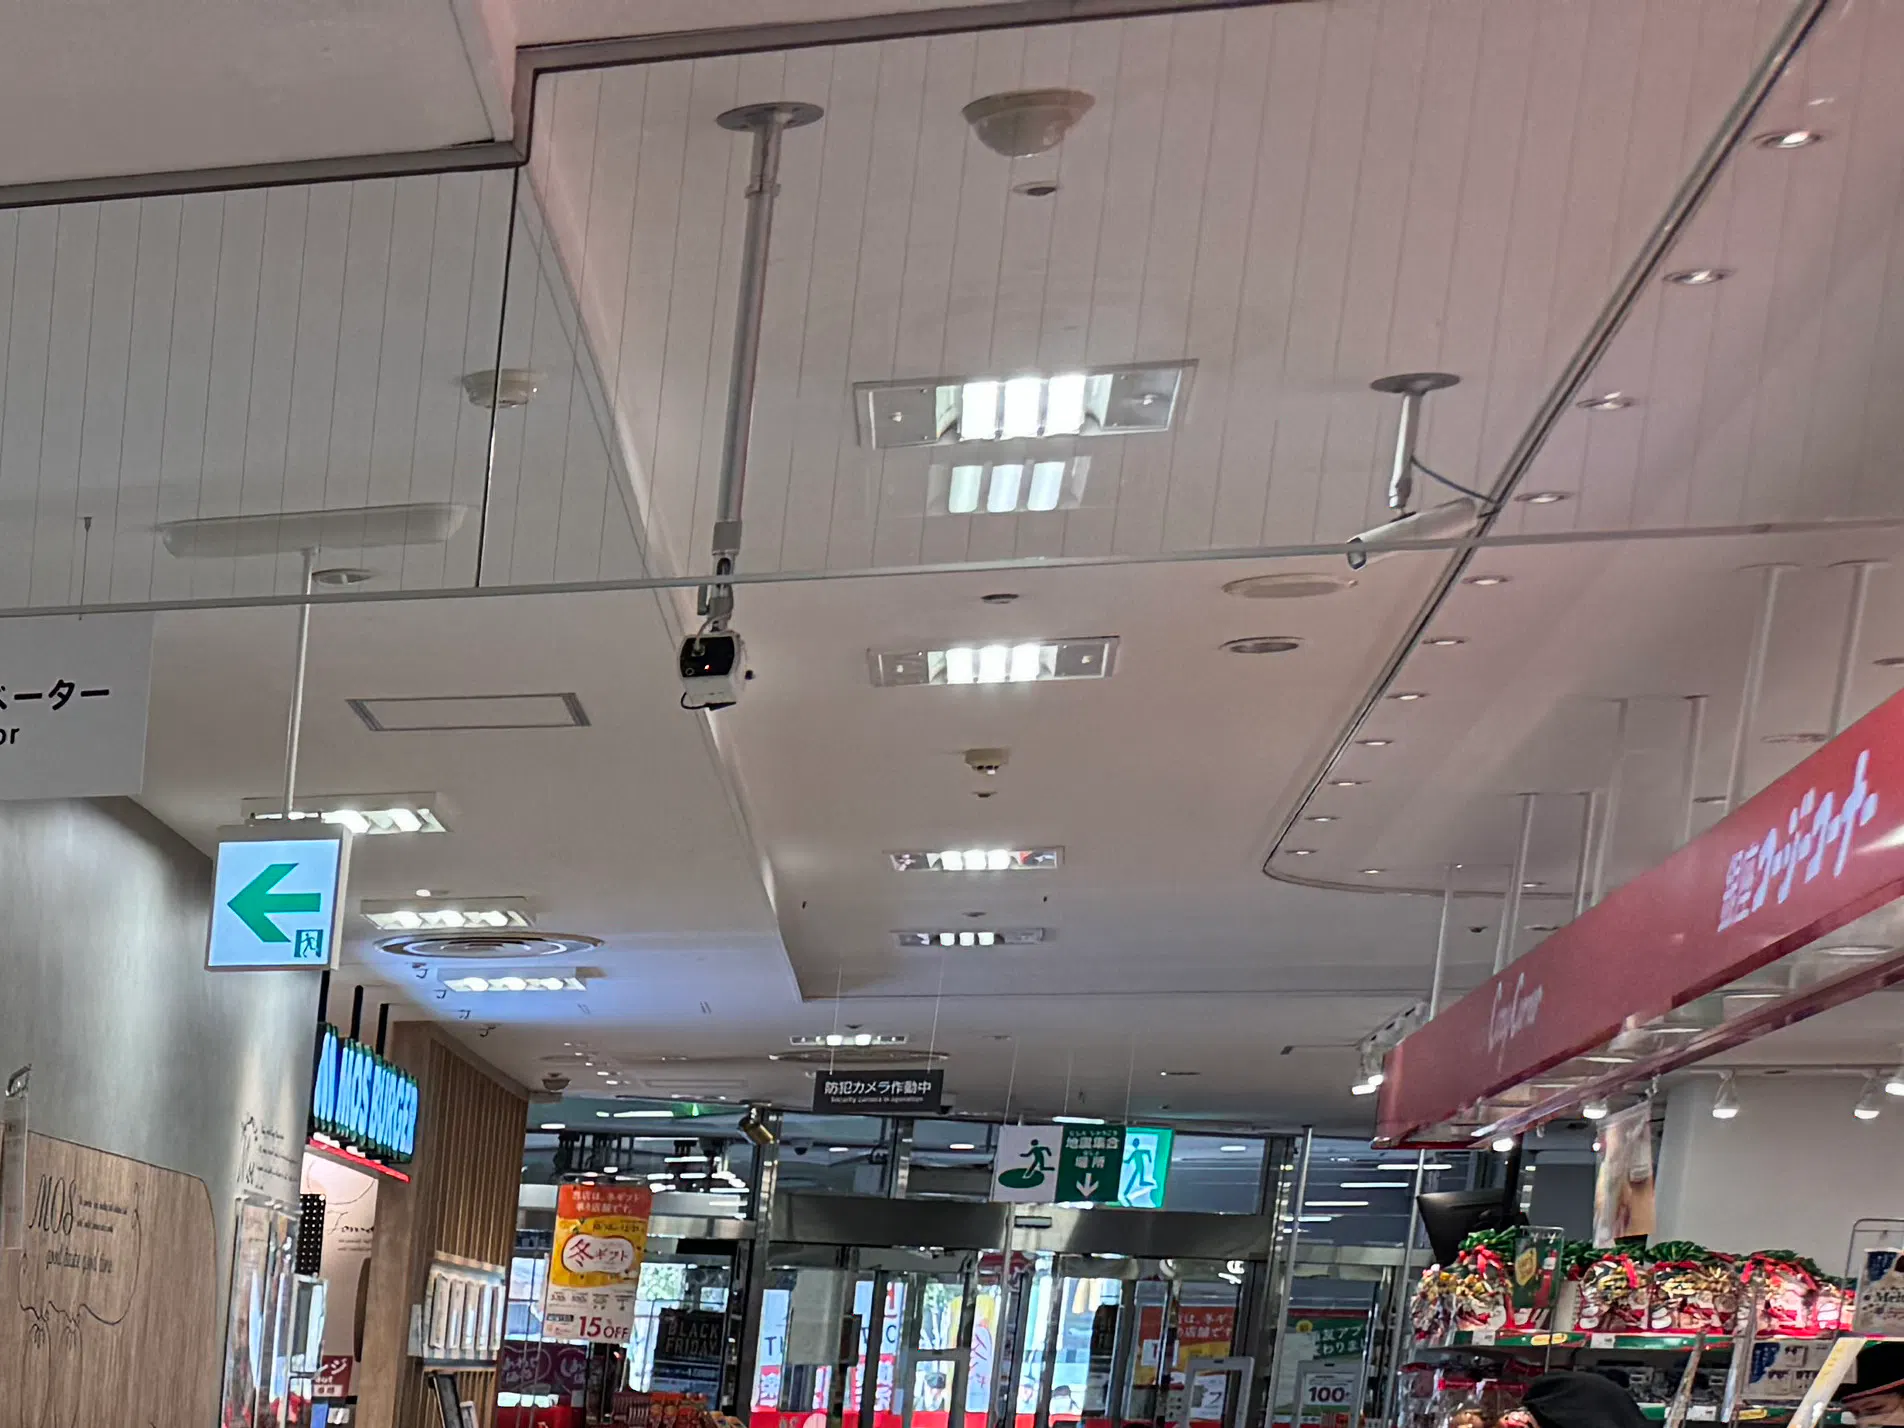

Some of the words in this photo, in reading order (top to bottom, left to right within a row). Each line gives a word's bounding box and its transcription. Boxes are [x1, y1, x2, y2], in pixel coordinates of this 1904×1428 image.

[823, 1080, 933, 1096] 防犯カメラ作動中
[1064, 1135, 1120, 1151] 地震集合
[28, 1173, 77, 1236] MOS
[567, 1238, 629, 1268] 冬ギフト
[603, 1326, 630, 1340] OFF
[667, 1320, 720, 1339] BLACK
[665, 1337, 719, 1355] FRIDAY
